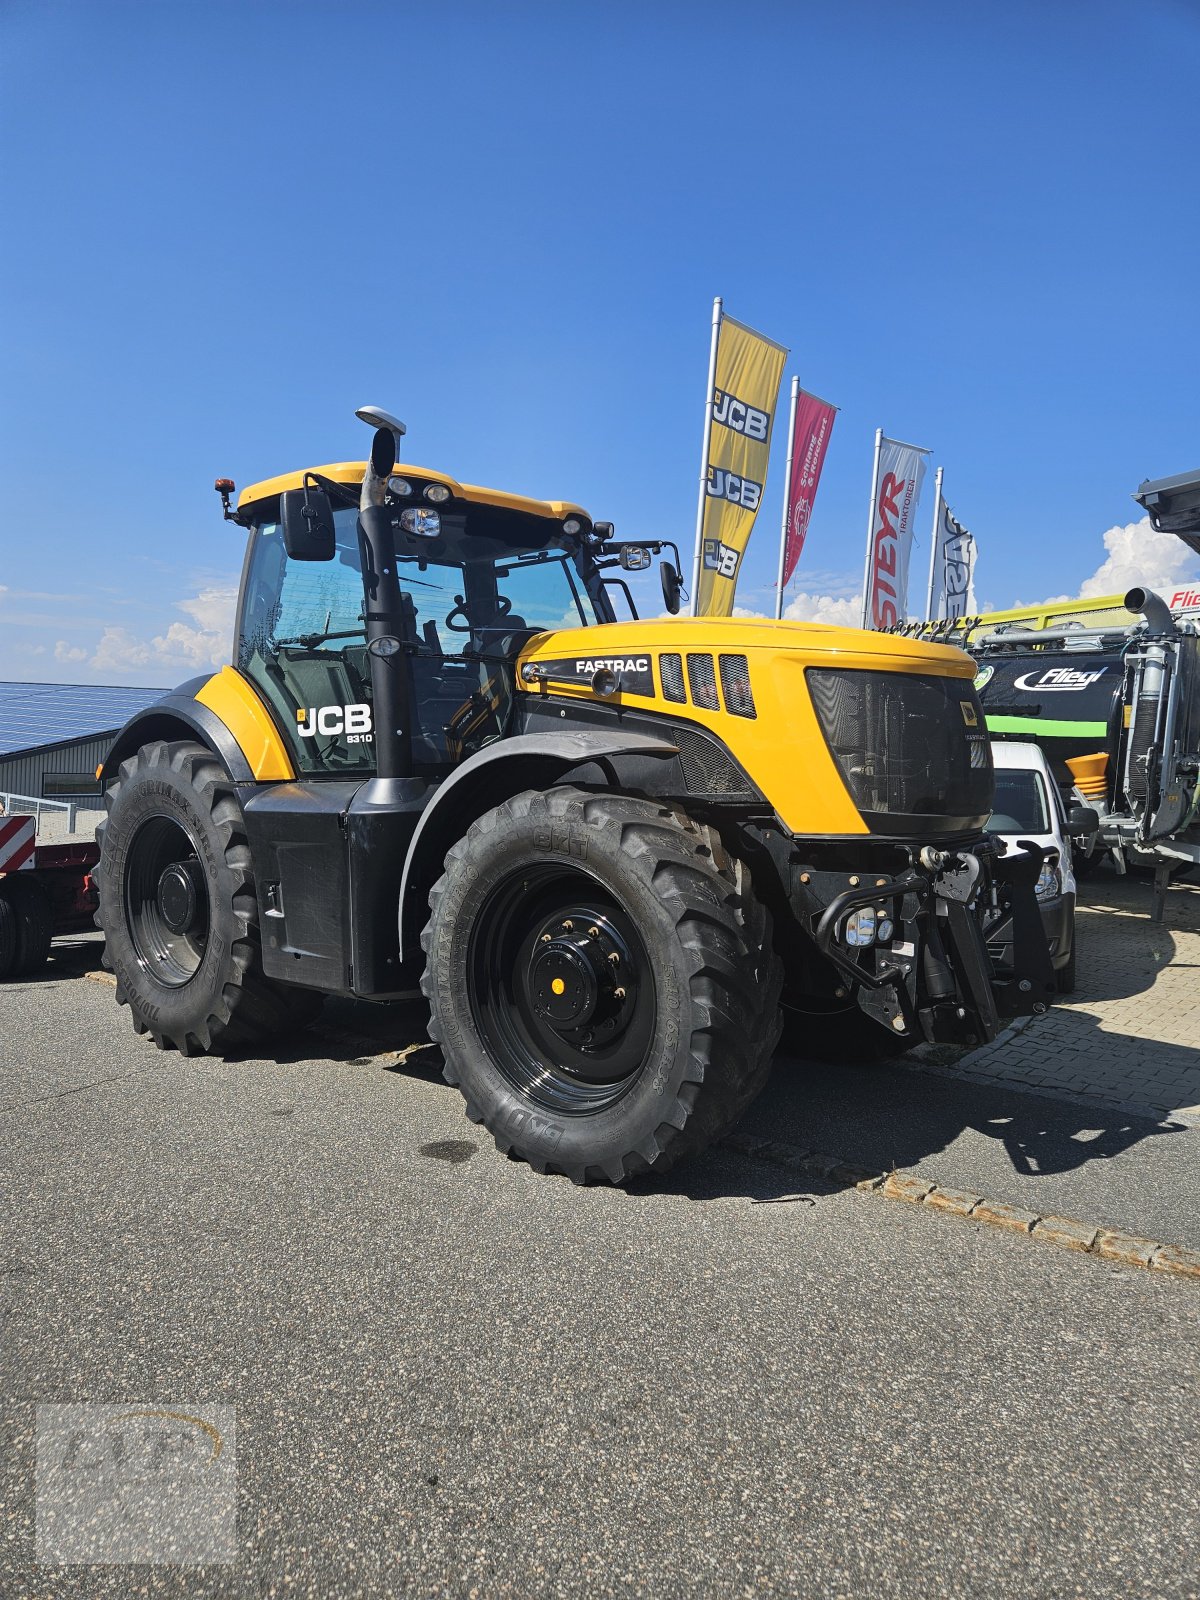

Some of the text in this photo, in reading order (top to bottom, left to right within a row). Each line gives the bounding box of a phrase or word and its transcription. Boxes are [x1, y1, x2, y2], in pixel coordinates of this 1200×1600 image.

[713, 394, 768, 440] JCB
[800, 433, 817, 488] Schlang
[707, 470, 761, 510] JCB
[900, 479, 916, 534] TRAKTOREN
[872, 471, 905, 629] STEYR
[575, 658, 648, 674] FASTRAC
[1036, 666, 1109, 691] Fliegl
[296, 703, 372, 737] JCB
[346, 734, 373, 744] 8310
[535, 829, 589, 860] BKT
[507, 1110, 565, 1150] BKT
